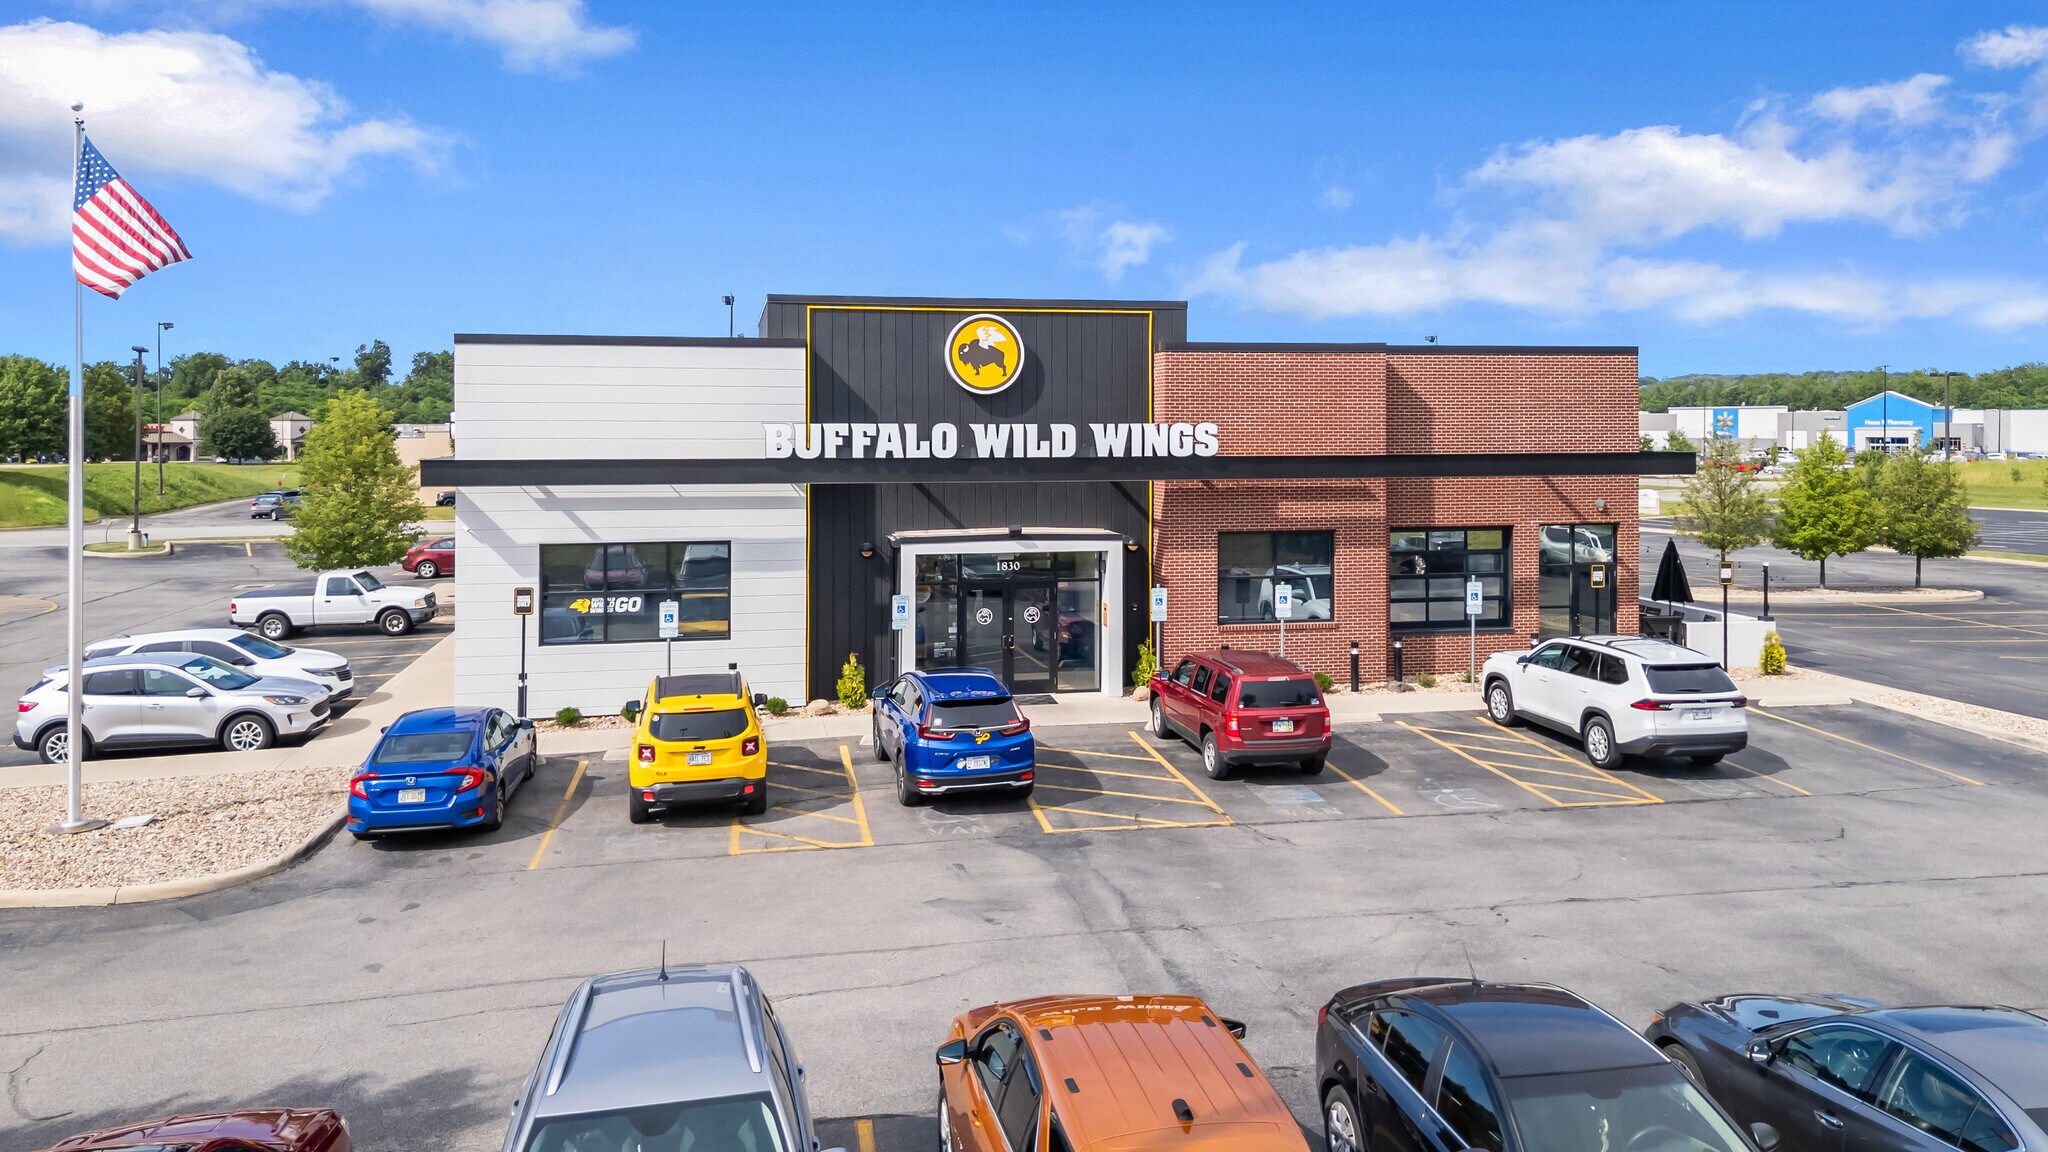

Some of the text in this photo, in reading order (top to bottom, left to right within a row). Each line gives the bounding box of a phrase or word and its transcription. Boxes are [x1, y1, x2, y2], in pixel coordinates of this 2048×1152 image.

[761, 422, 1220, 459] BUFFALO WILD WINGS
[996, 561, 1020, 571] 1830
[614, 596, 642, 613] GO
